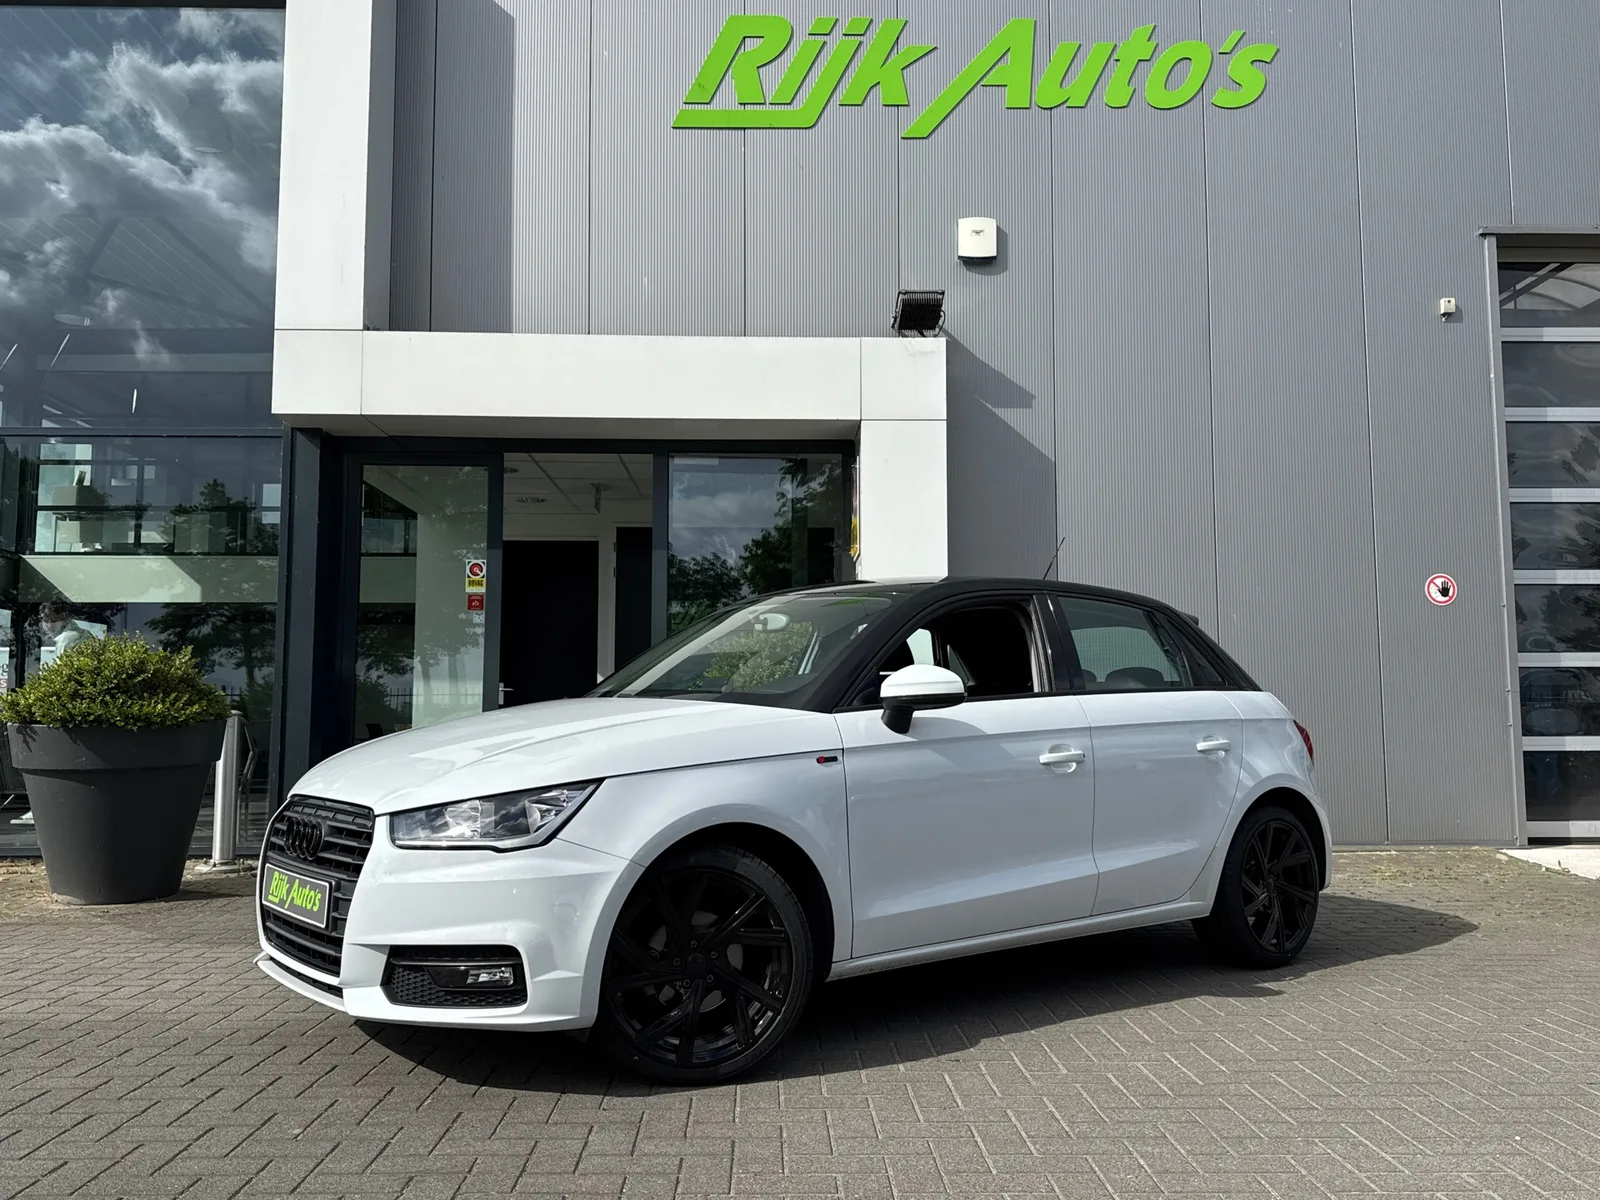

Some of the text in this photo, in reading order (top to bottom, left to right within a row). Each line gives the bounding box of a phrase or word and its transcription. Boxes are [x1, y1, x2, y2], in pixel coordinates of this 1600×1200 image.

[672, 14, 1278, 138] Rijk Auto's
[267, 871, 322, 912] Rijk Auto's
